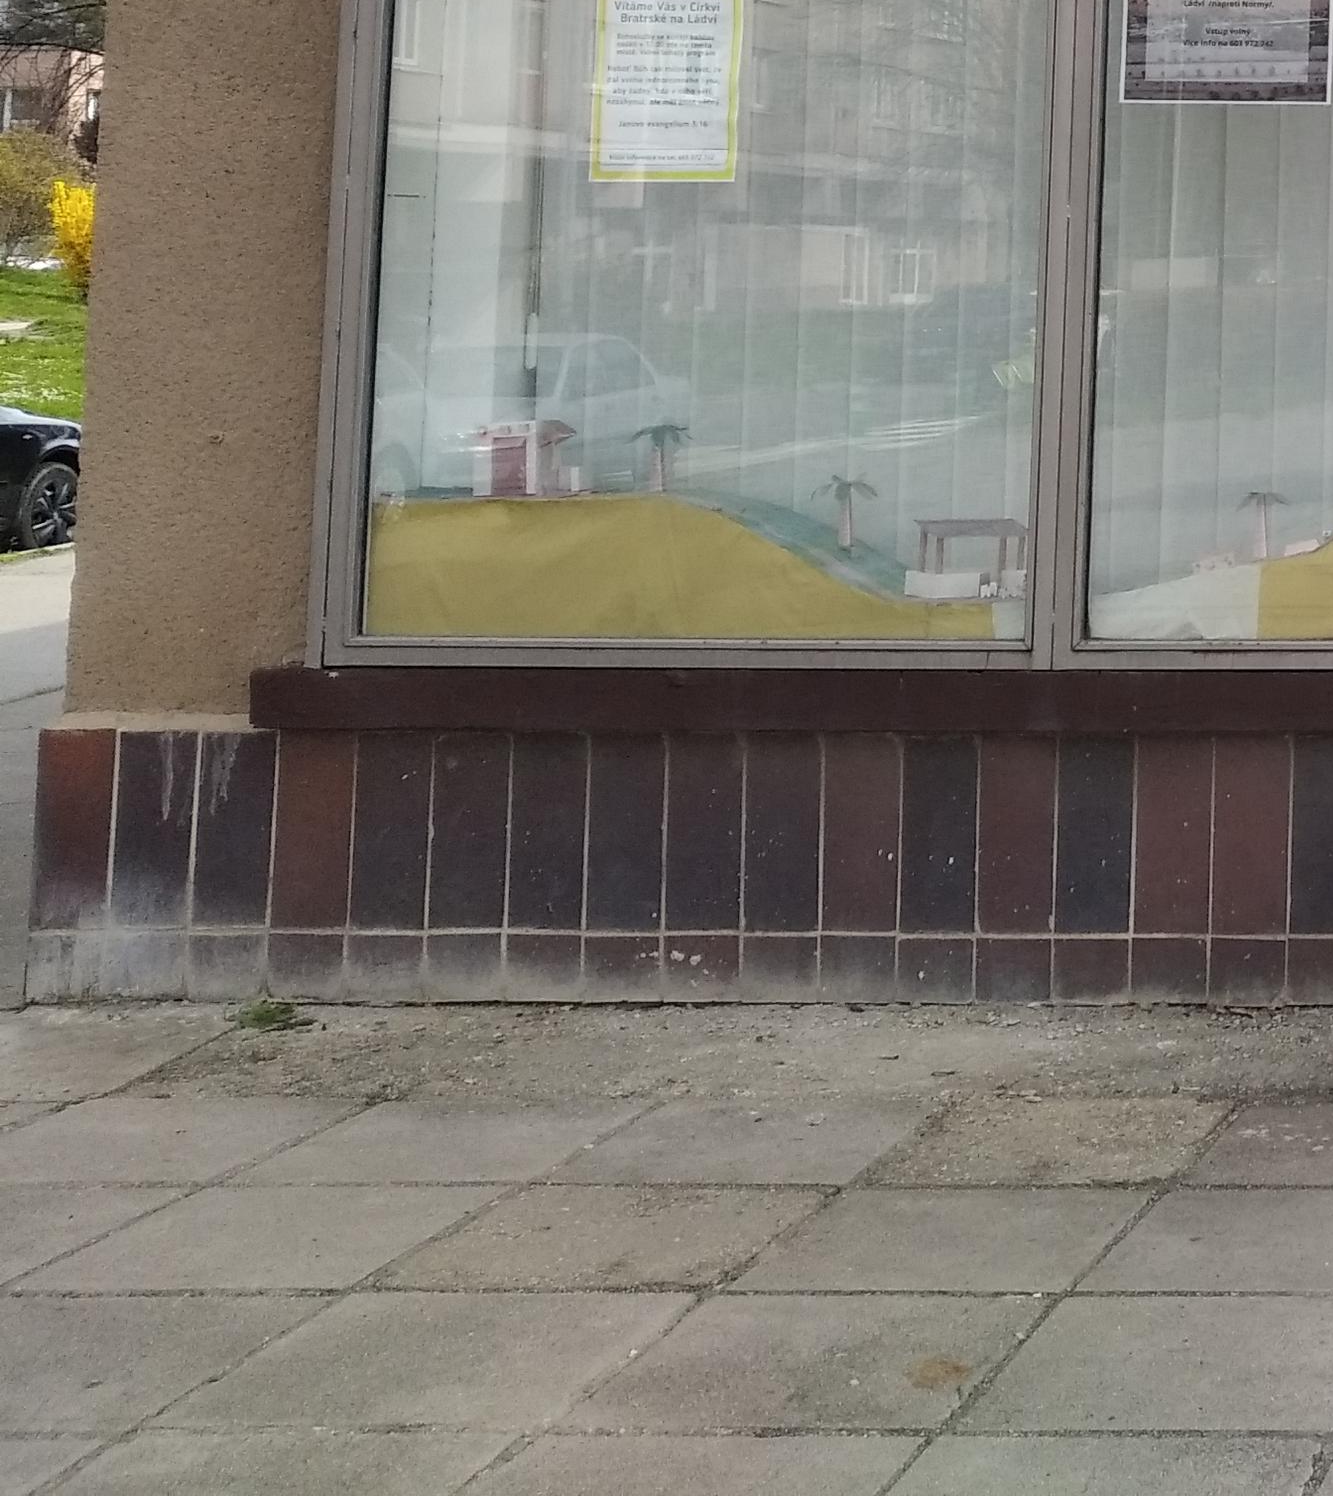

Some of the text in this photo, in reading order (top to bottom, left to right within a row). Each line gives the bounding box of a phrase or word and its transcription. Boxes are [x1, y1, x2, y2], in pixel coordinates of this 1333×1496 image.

[657, 1, 677, 12] Vás
[680, 4, 687, 12] v
[620, 12, 667, 24] Bratrské
[670, 15, 684, 24] na
